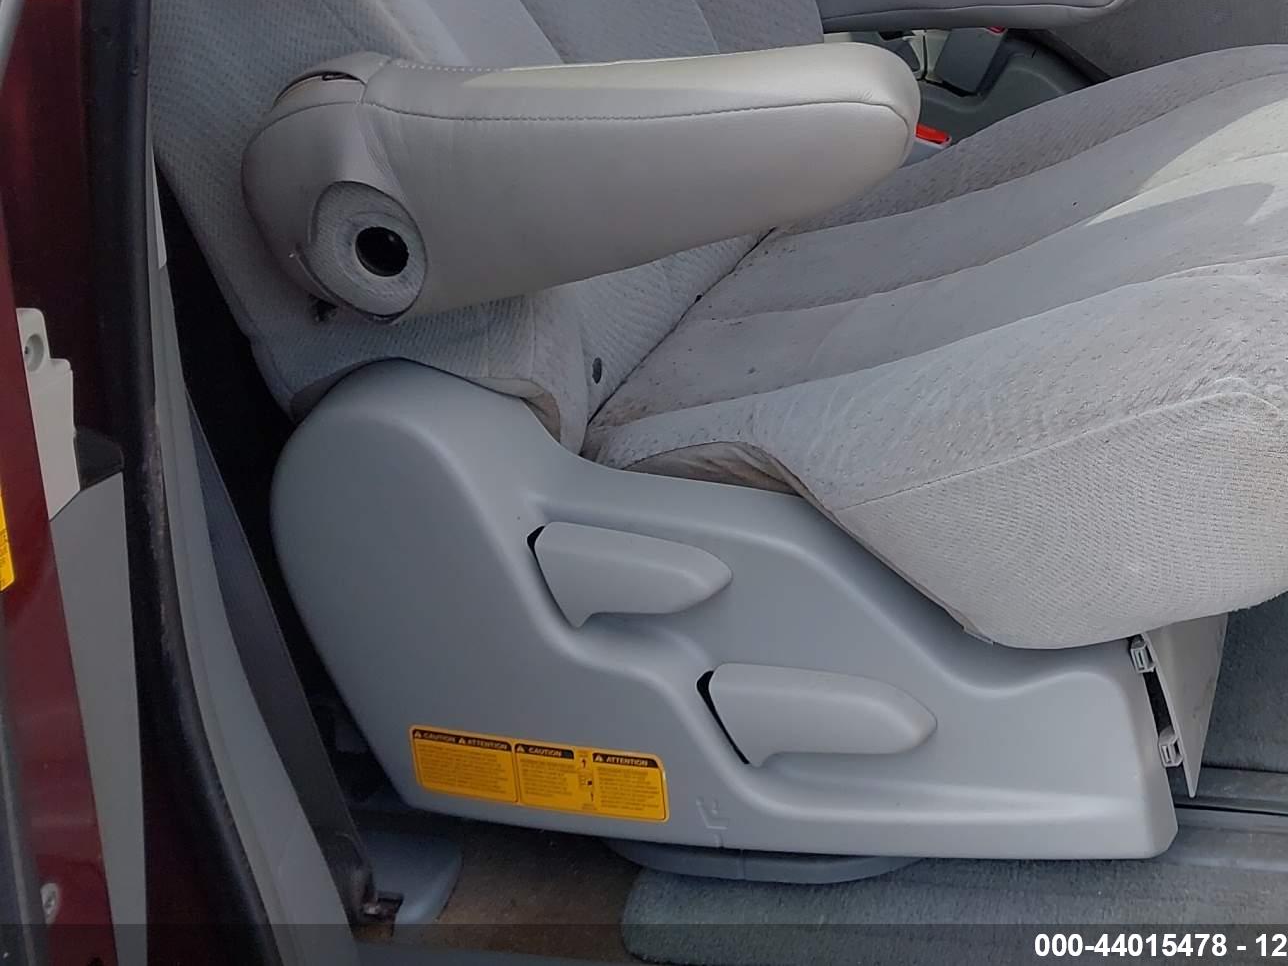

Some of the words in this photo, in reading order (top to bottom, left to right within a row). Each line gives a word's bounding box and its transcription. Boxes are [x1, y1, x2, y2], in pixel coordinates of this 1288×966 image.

[423, 732, 456, 744] CAUTION
[467, 738, 508, 751] ATTENTION
[528, 747, 562, 758] CAUTION
[606, 755, 649, 767] ATTENTION
